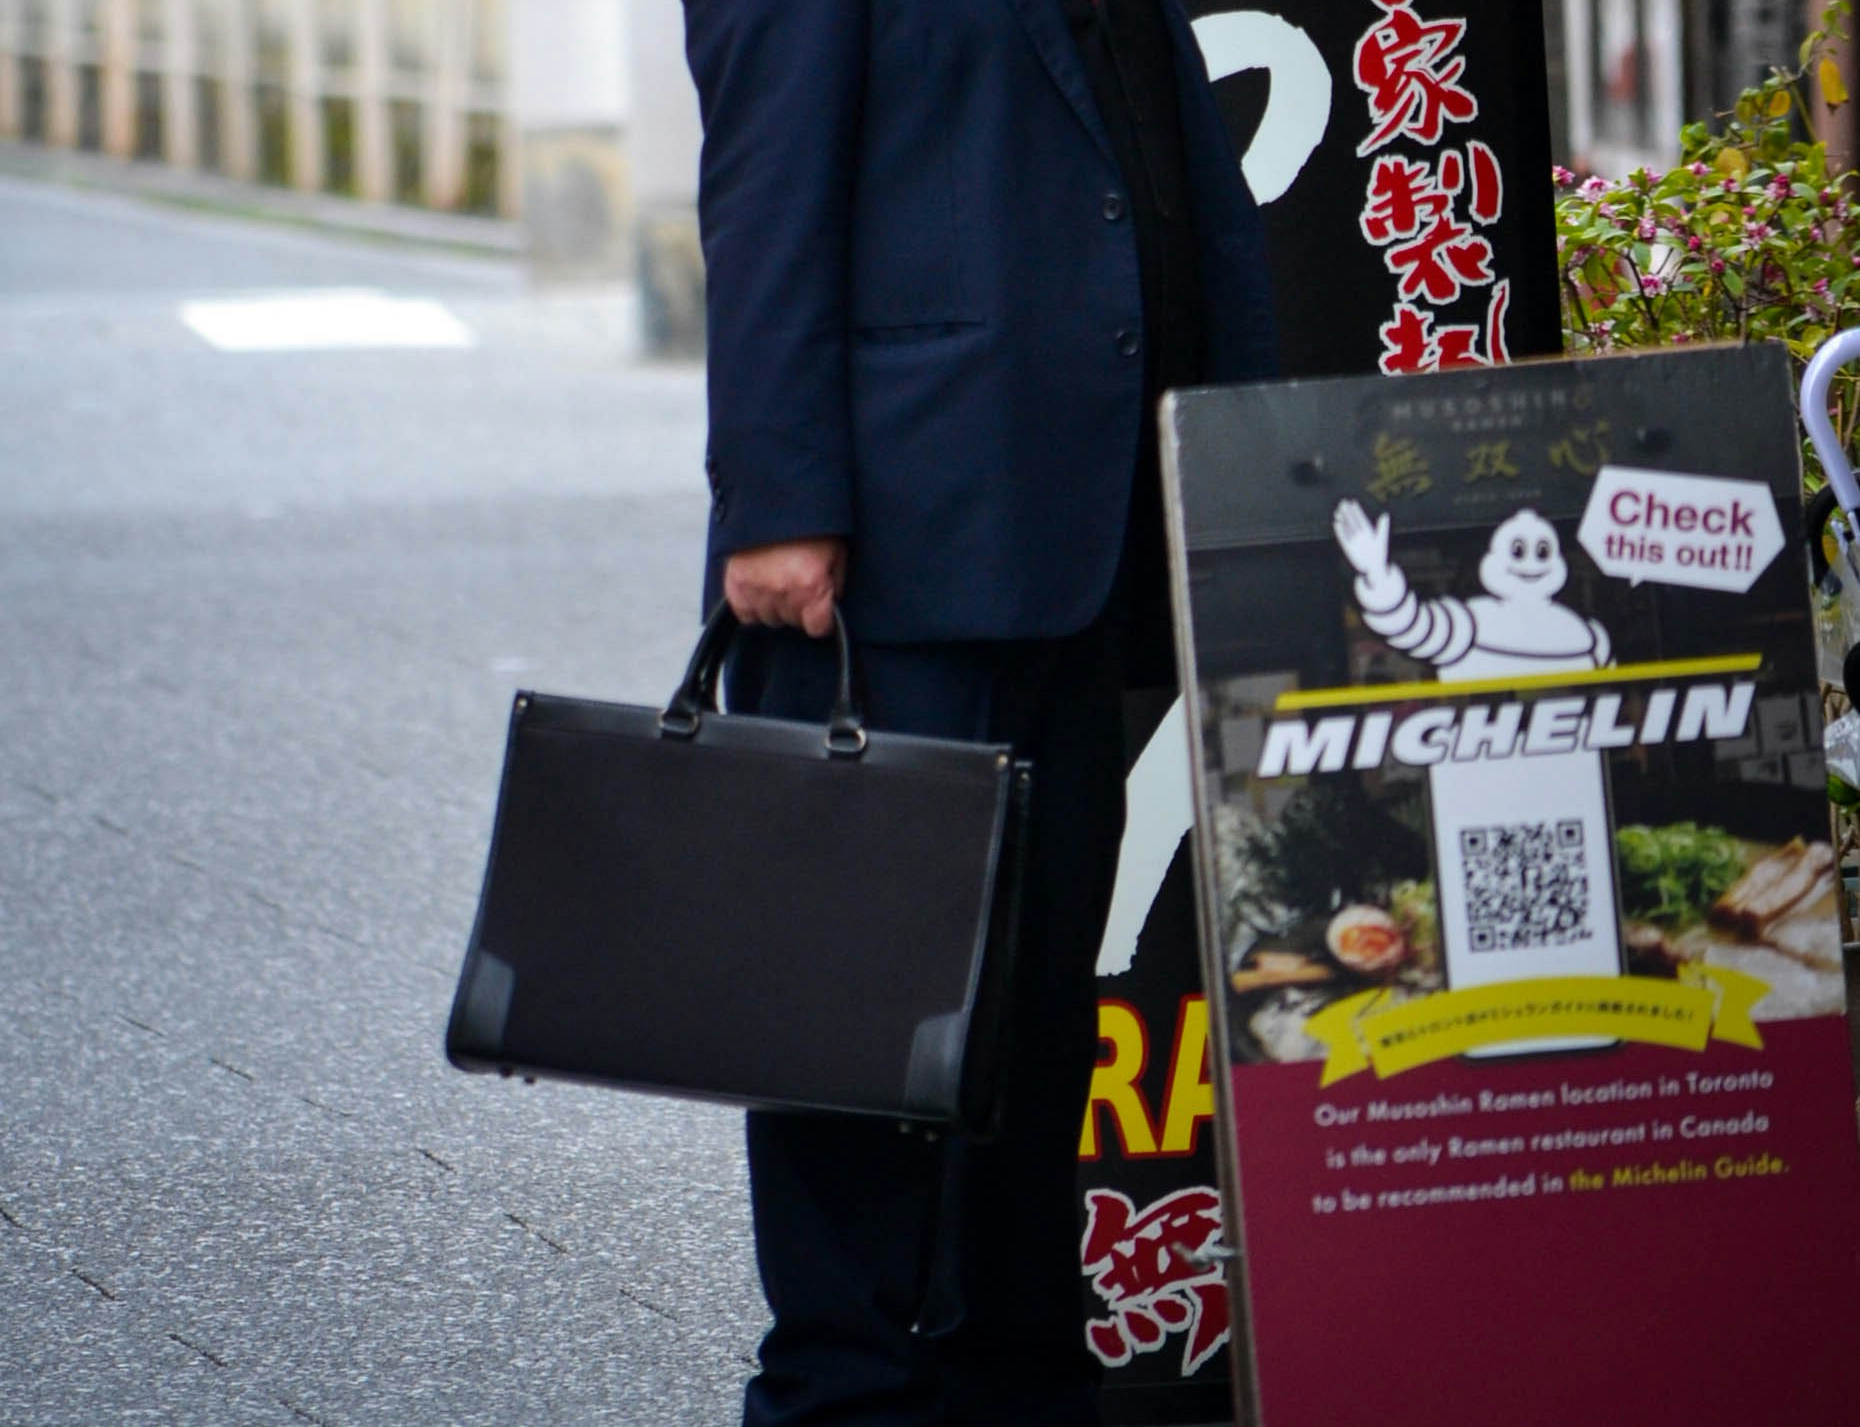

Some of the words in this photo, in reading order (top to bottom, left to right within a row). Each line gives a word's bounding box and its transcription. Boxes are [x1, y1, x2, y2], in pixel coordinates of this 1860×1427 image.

[1608, 489, 1754, 538] Check
[1605, 534, 1664, 563] this
[1675, 543, 1754, 572] out!!
[1257, 680, 1757, 779] MICHELIN
[1314, 1103, 1360, 1126] Our
[1366, 1094, 1473, 1122] Musoshin
[1478, 1089, 1556, 1112] Ramen
[1560, 1078, 1653, 1106] location
[1658, 1073, 1681, 1097] in
[1685, 1069, 1774, 1095] Toronto
[1326, 1146, 1346, 1169] is
[1351, 1143, 1387, 1166] the
[1392, 1136, 1442, 1166] only
[1448, 1135, 1525, 1158] Ramen
[1530, 1122, 1646, 1152] restaurant
[1652, 1119, 1673, 1141] in
[1679, 1111, 1770, 1139] Canada
[1312, 1193, 1337, 1214] to
[1341, 1186, 1372, 1212] be
[1378, 1173, 1536, 1208] recommended
[1541, 1174, 1564, 1194] in
[1569, 1169, 1604, 1192] the
[1612, 1160, 1708, 1188] Michelin
